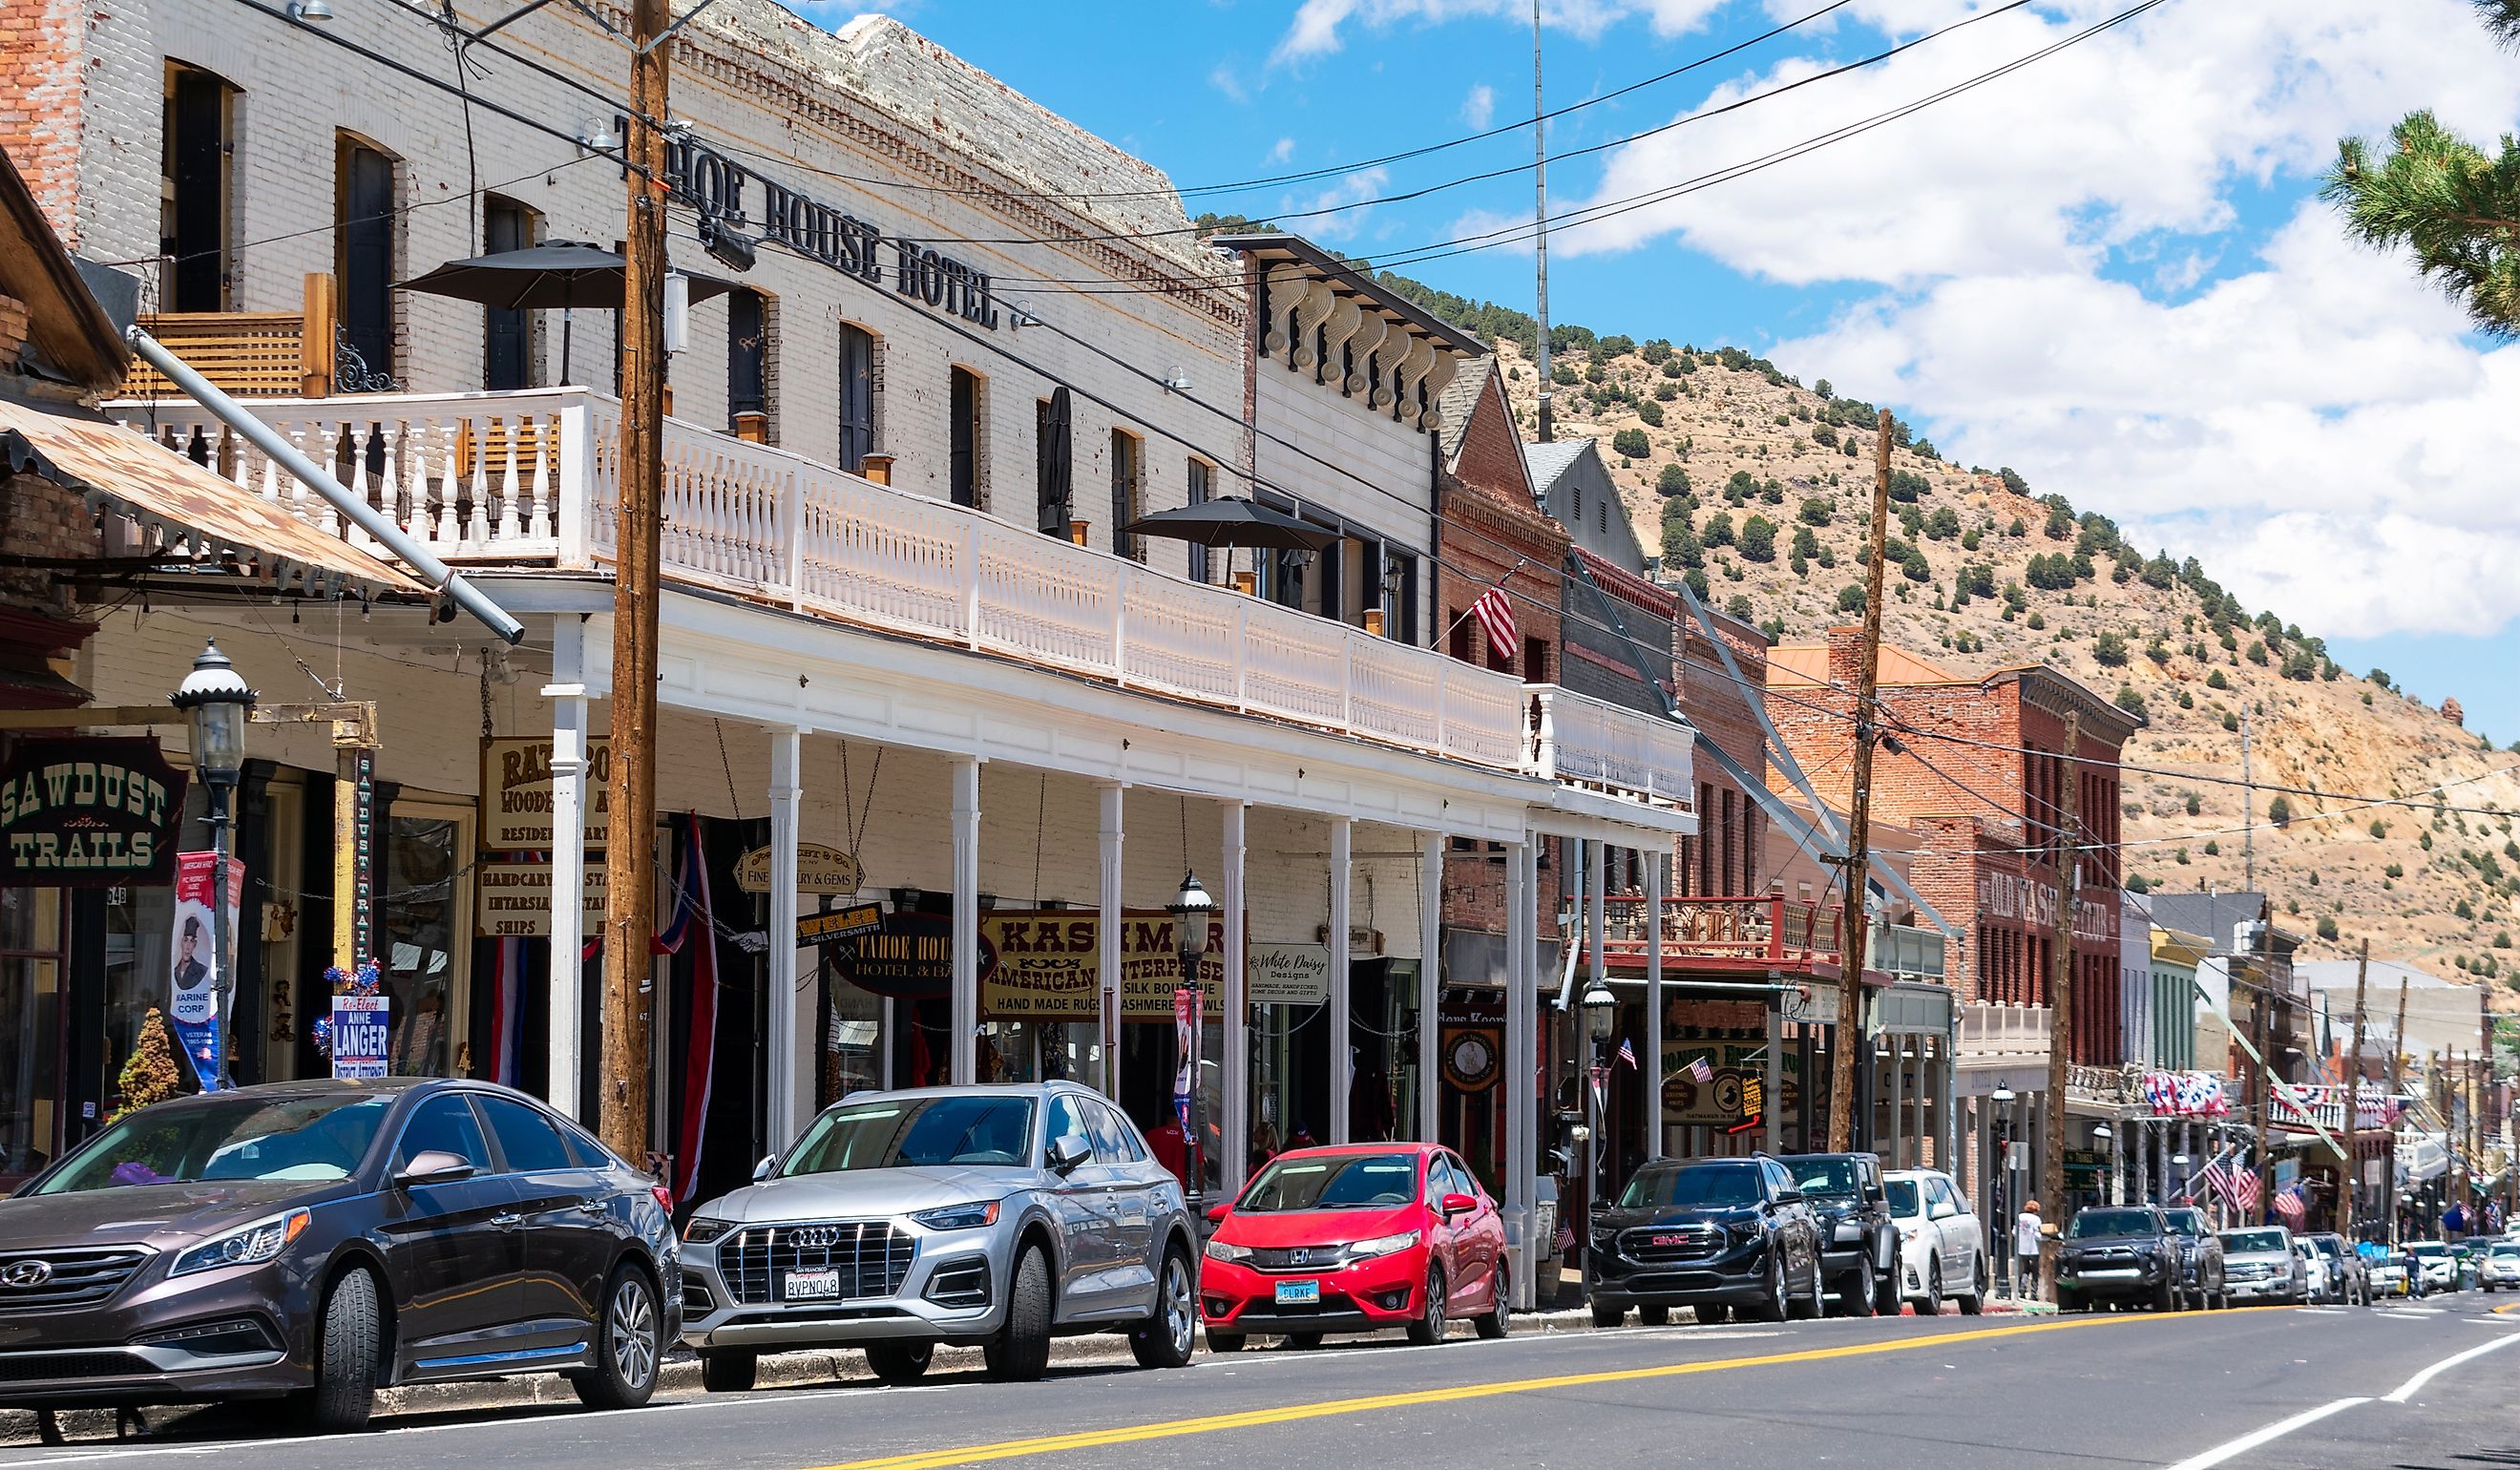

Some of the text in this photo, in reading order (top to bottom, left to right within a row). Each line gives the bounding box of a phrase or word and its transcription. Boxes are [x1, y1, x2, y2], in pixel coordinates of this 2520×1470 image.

[615, 115, 998, 330] THOE HOUSE HOTEL
[0, 763, 168, 829] SAWDUST
[501, 790, 554, 813] WOODE
[358, 759, 370, 867] SAWDUST
[10, 831, 154, 869] TRAILS
[747, 871, 768, 883] FINE
[814, 872, 823, 885] &
[824, 872, 850, 886] GEMS
[495, 920, 536, 934] SHIPS
[797, 908, 878, 938] WELER
[810, 924, 881, 943] SILVERSMITH
[856, 934, 953, 960] TAHOE HOU
[1001, 921, 1224, 953] KASMR
[855, 964, 953, 977] HOTEL & BA
[1260, 950, 1327, 975] White Daisy
[989, 966, 1096, 991] AMERICAN
[1270, 971, 1310, 980] Designs
[1124, 982, 1215, 995] SILK BOUTUE
[343, 998, 379, 1011] Re-Elect
[998, 998, 1030, 1010] HAND
[1034, 998, 1068, 1010] MADE
[1121, 999, 1174, 1011] ASHMERE
[348, 1012, 371, 1024] ANNE
[334, 1025, 388, 1056] LANGER
[1652, 1234, 1689, 1246] GMC
